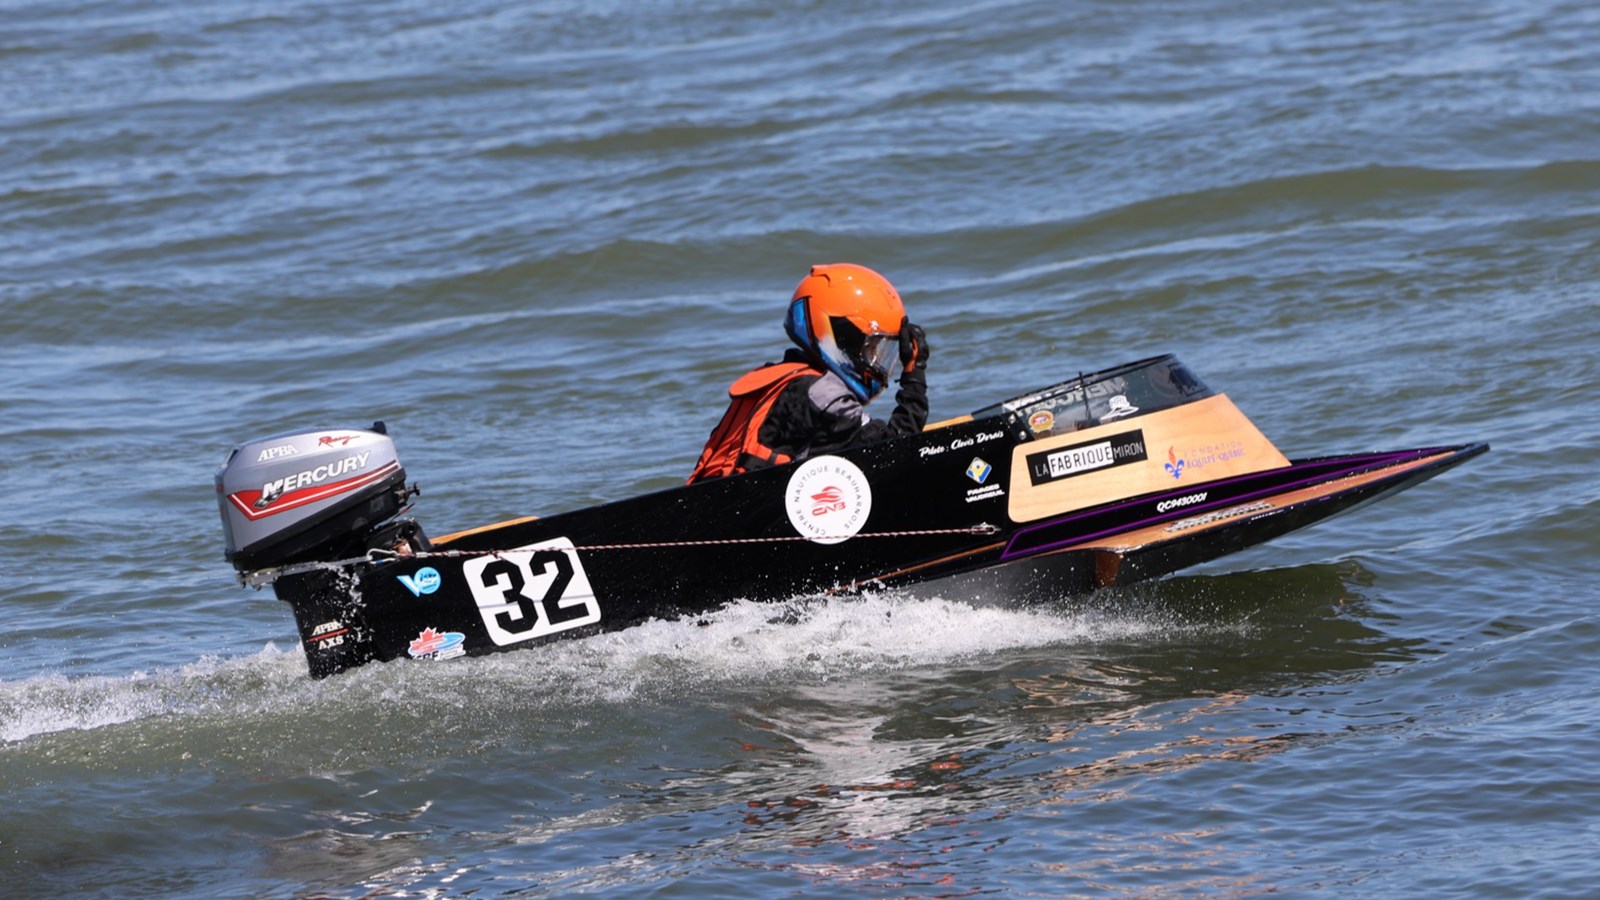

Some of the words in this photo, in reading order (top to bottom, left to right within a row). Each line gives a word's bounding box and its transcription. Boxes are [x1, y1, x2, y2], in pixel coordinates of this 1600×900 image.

[257, 444, 298, 462] APBA
[919, 445, 945, 458] Pilote
[950, 437, 975, 450] Clovis
[976, 430, 1004, 444] Dorais
[1034, 463, 1050, 478] LA
[1050, 445, 1113, 473] FABRIQUE
[1113, 441, 1144, 460] MIRON
[261, 452, 370, 500] MERCURY
[794, 465, 829, 503] NAUTIQUE
[834, 466, 863, 530] BEAUHARNOIS
[480, 550, 590, 635] 32
